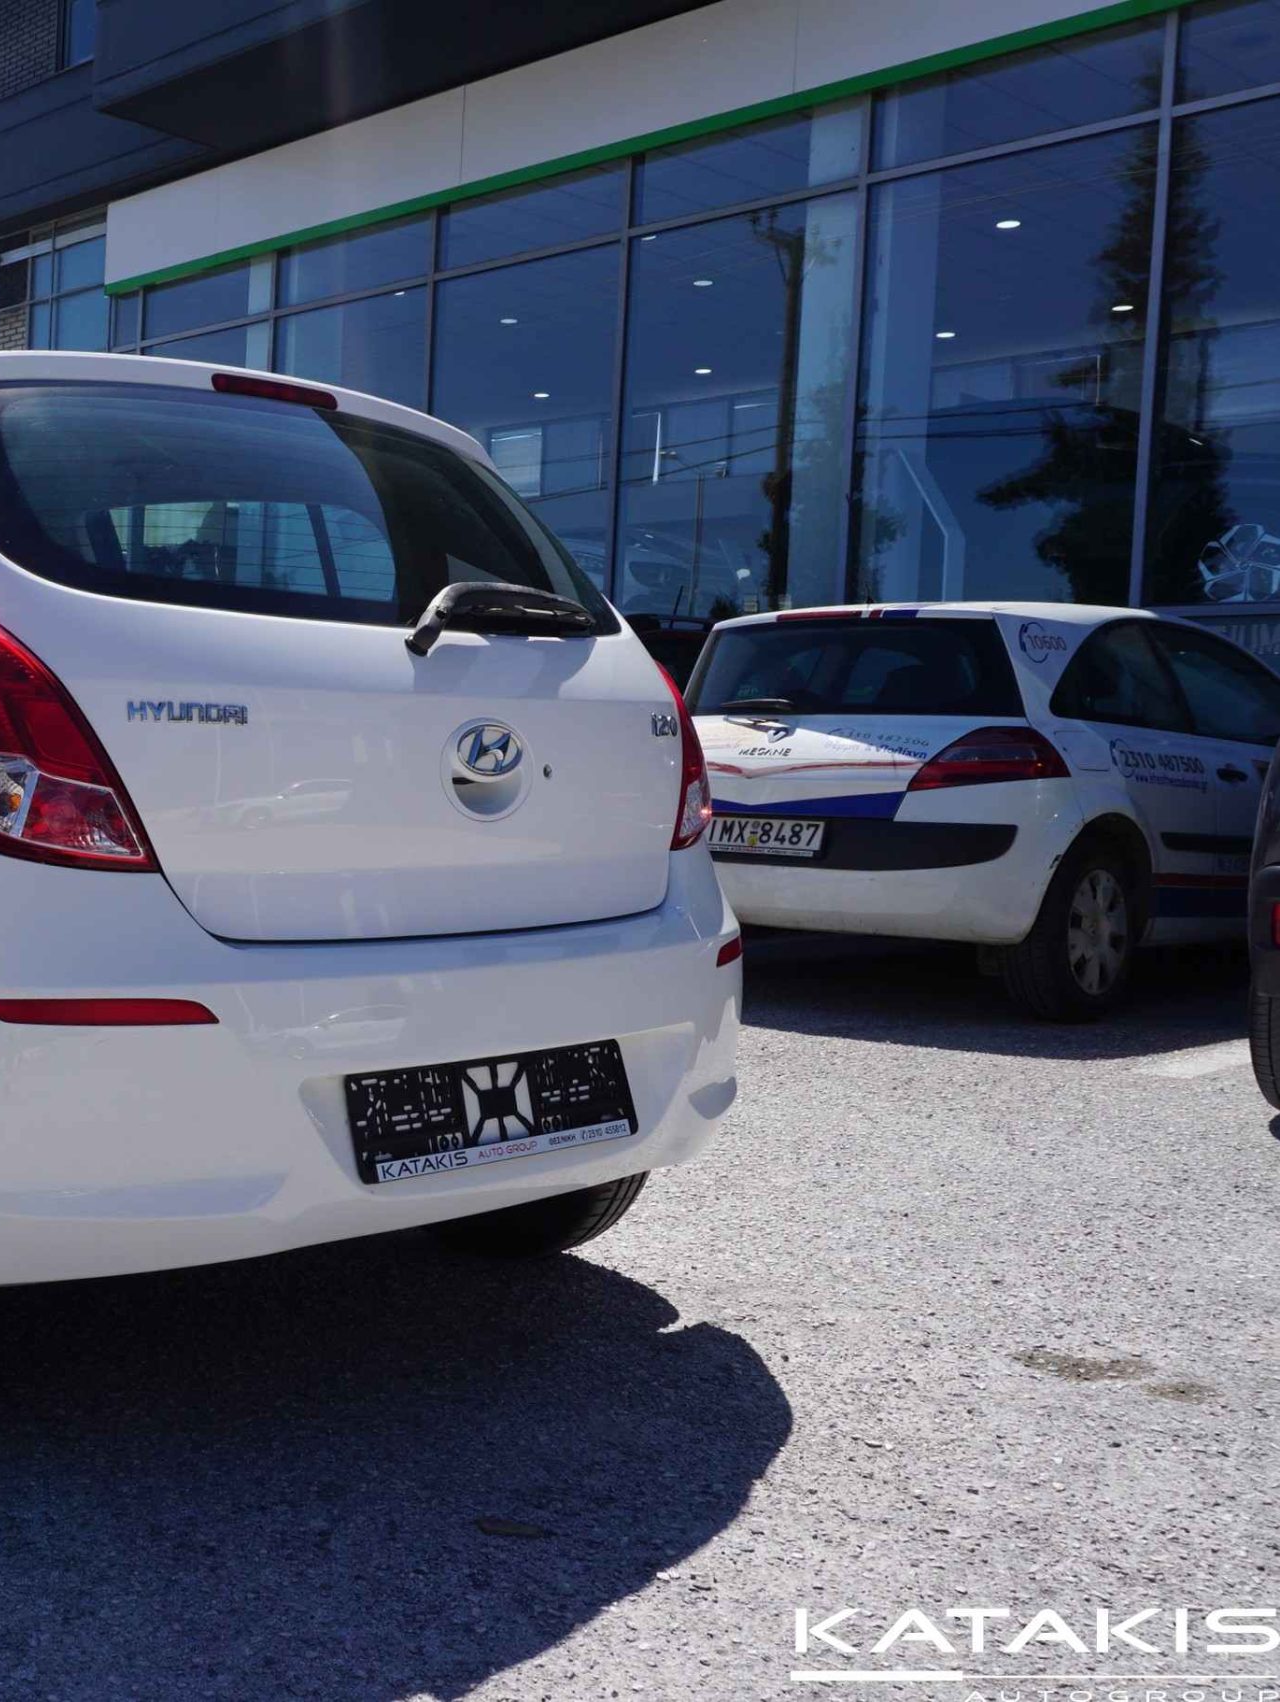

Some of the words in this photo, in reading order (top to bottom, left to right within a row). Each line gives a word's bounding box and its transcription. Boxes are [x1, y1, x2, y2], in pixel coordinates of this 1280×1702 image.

[127, 700, 249, 726] HYUNDAI
[738, 747, 792, 757] MEGANE
[381, 1151, 468, 1179] KATAKIS
[478, 1146, 504, 1159] AUTO
[506, 1140, 538, 1154] GROUP
